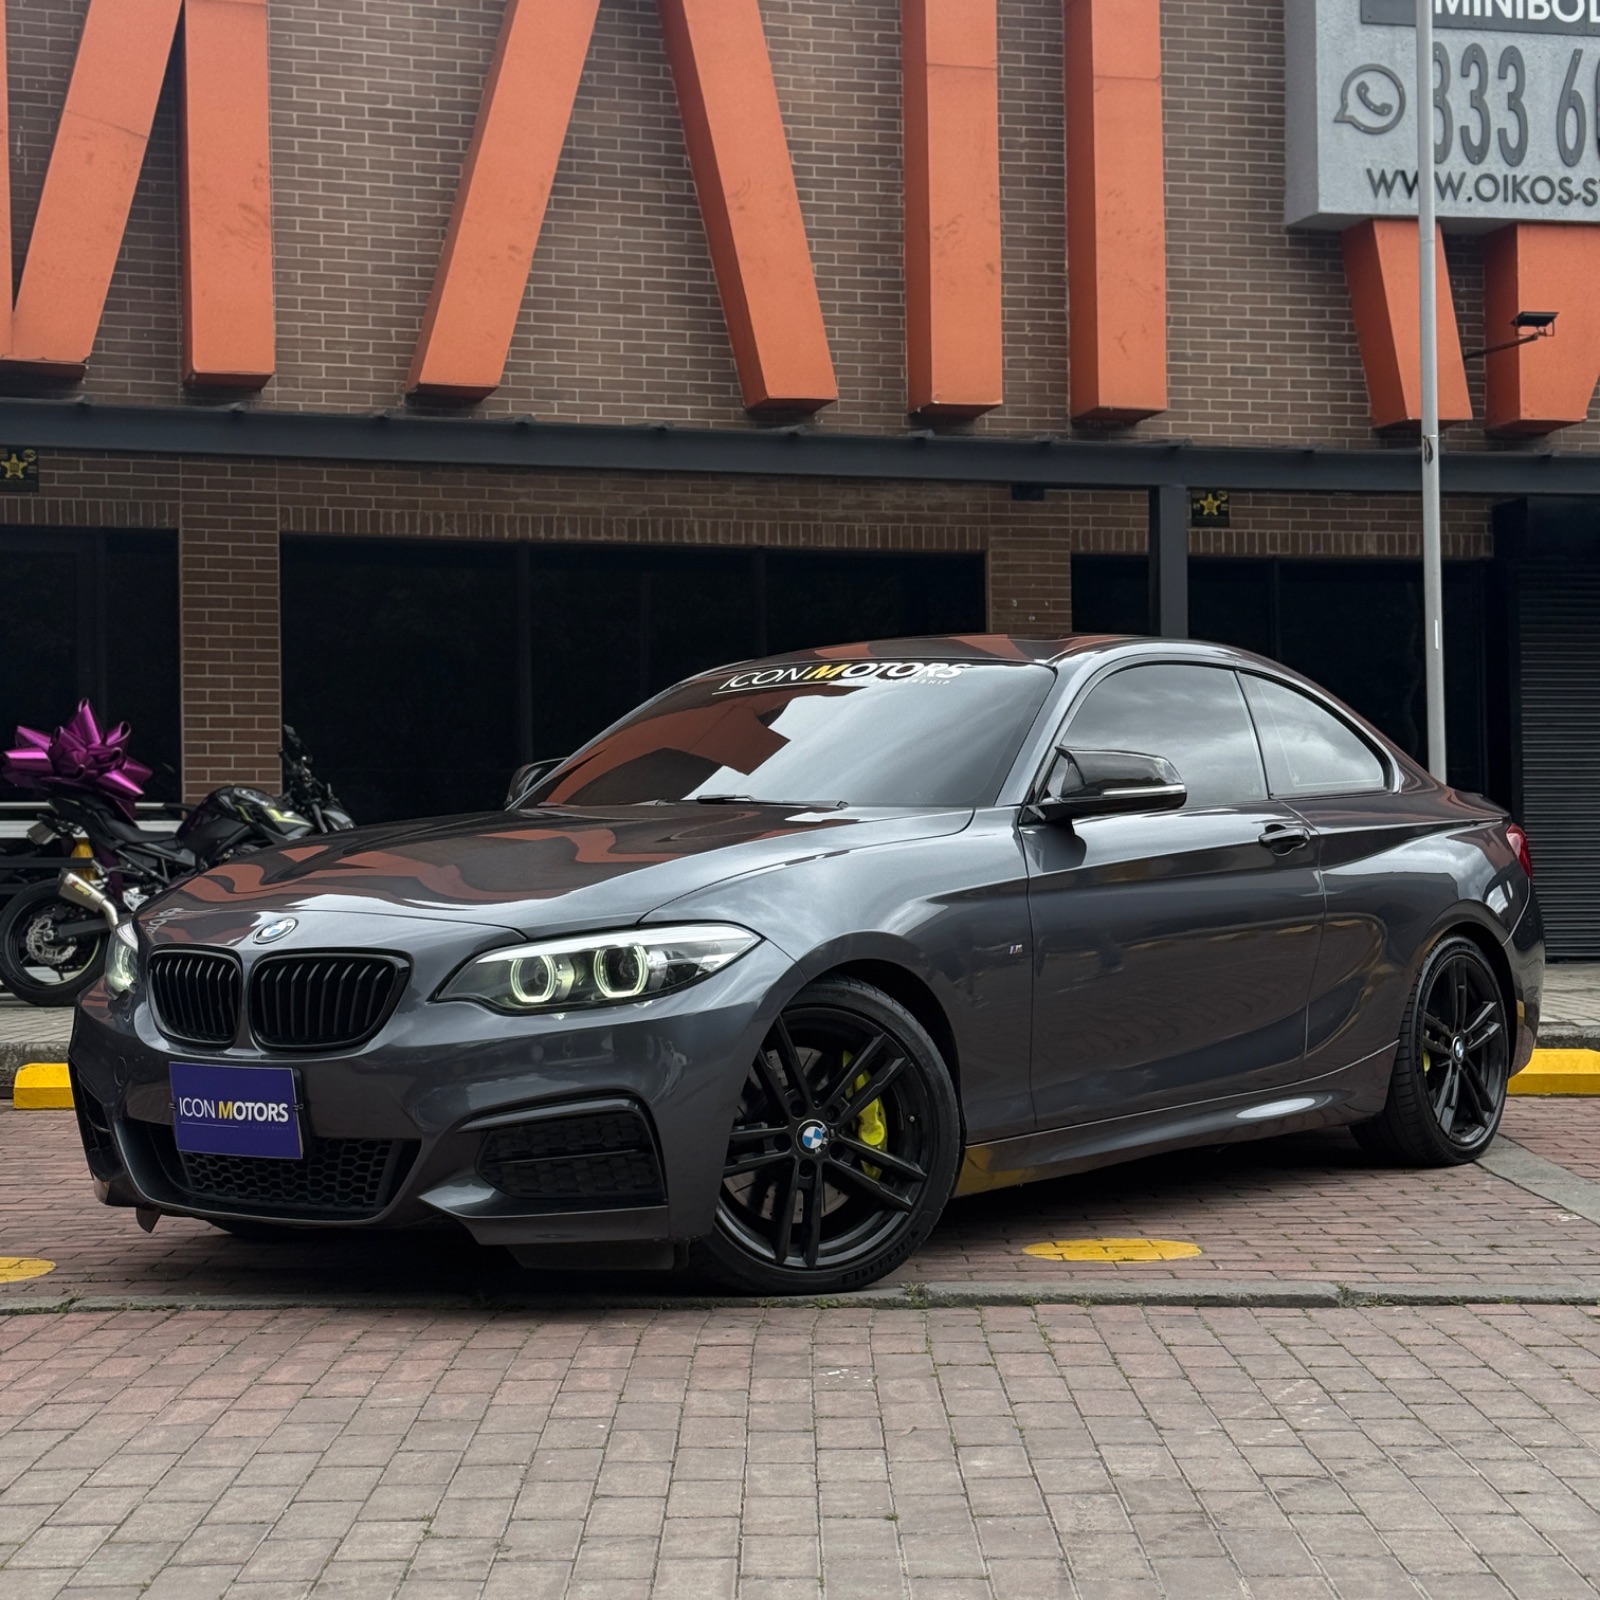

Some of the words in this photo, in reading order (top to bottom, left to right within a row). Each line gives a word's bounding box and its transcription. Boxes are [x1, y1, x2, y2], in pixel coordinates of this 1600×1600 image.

[1433, 41, 1528, 167] 333
[1556, 48, 1600, 167] 6
[719, 666, 812, 690] ICON
[803, 663, 969, 680] MOTORS
[179, 1097, 215, 1119] ICON
[218, 1101, 289, 1122] MOTORS
